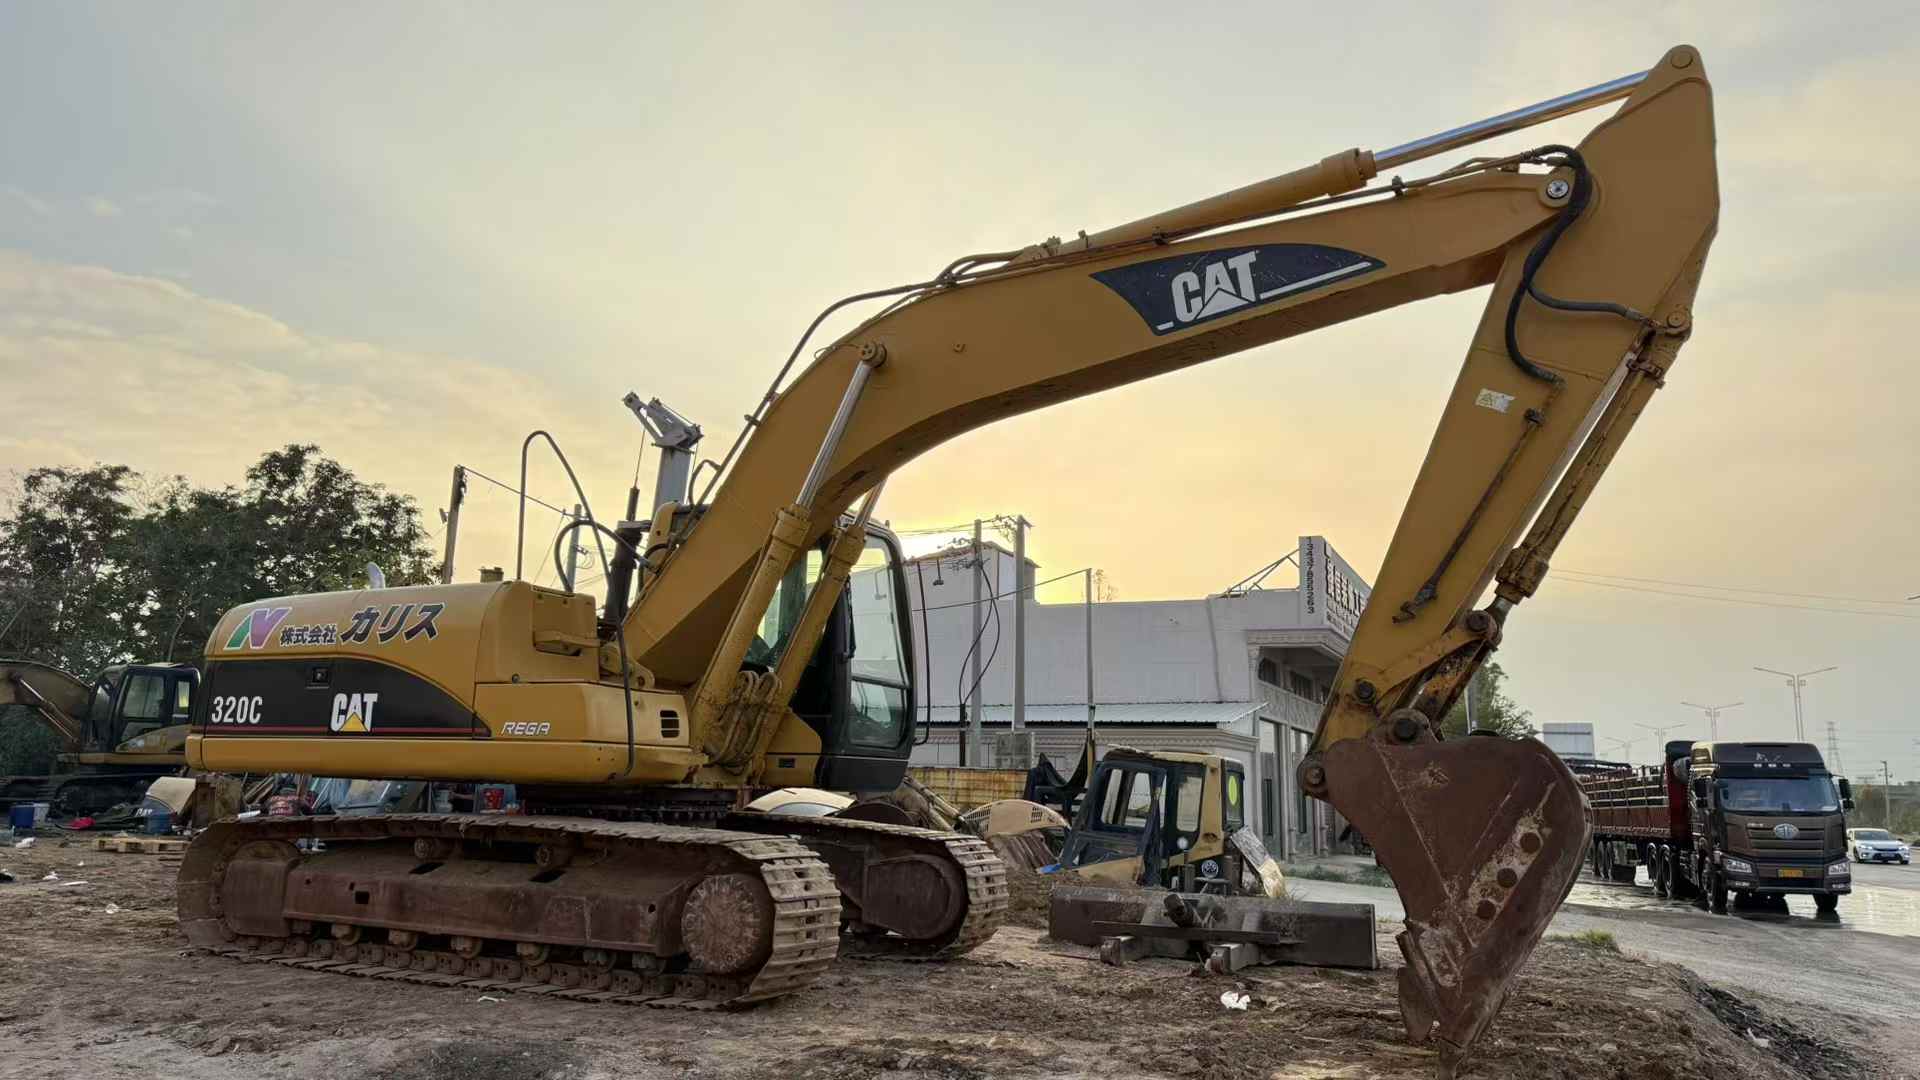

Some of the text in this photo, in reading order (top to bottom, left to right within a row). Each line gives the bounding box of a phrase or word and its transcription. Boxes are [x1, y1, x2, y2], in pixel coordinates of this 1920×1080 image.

[1172, 250, 1257, 322] CAT
[280, 603, 446, 646] 株式会社 カリス
[211, 695, 263, 724] 320C
[331, 693, 378, 732] CAT
[501, 721, 551, 735] REGA
